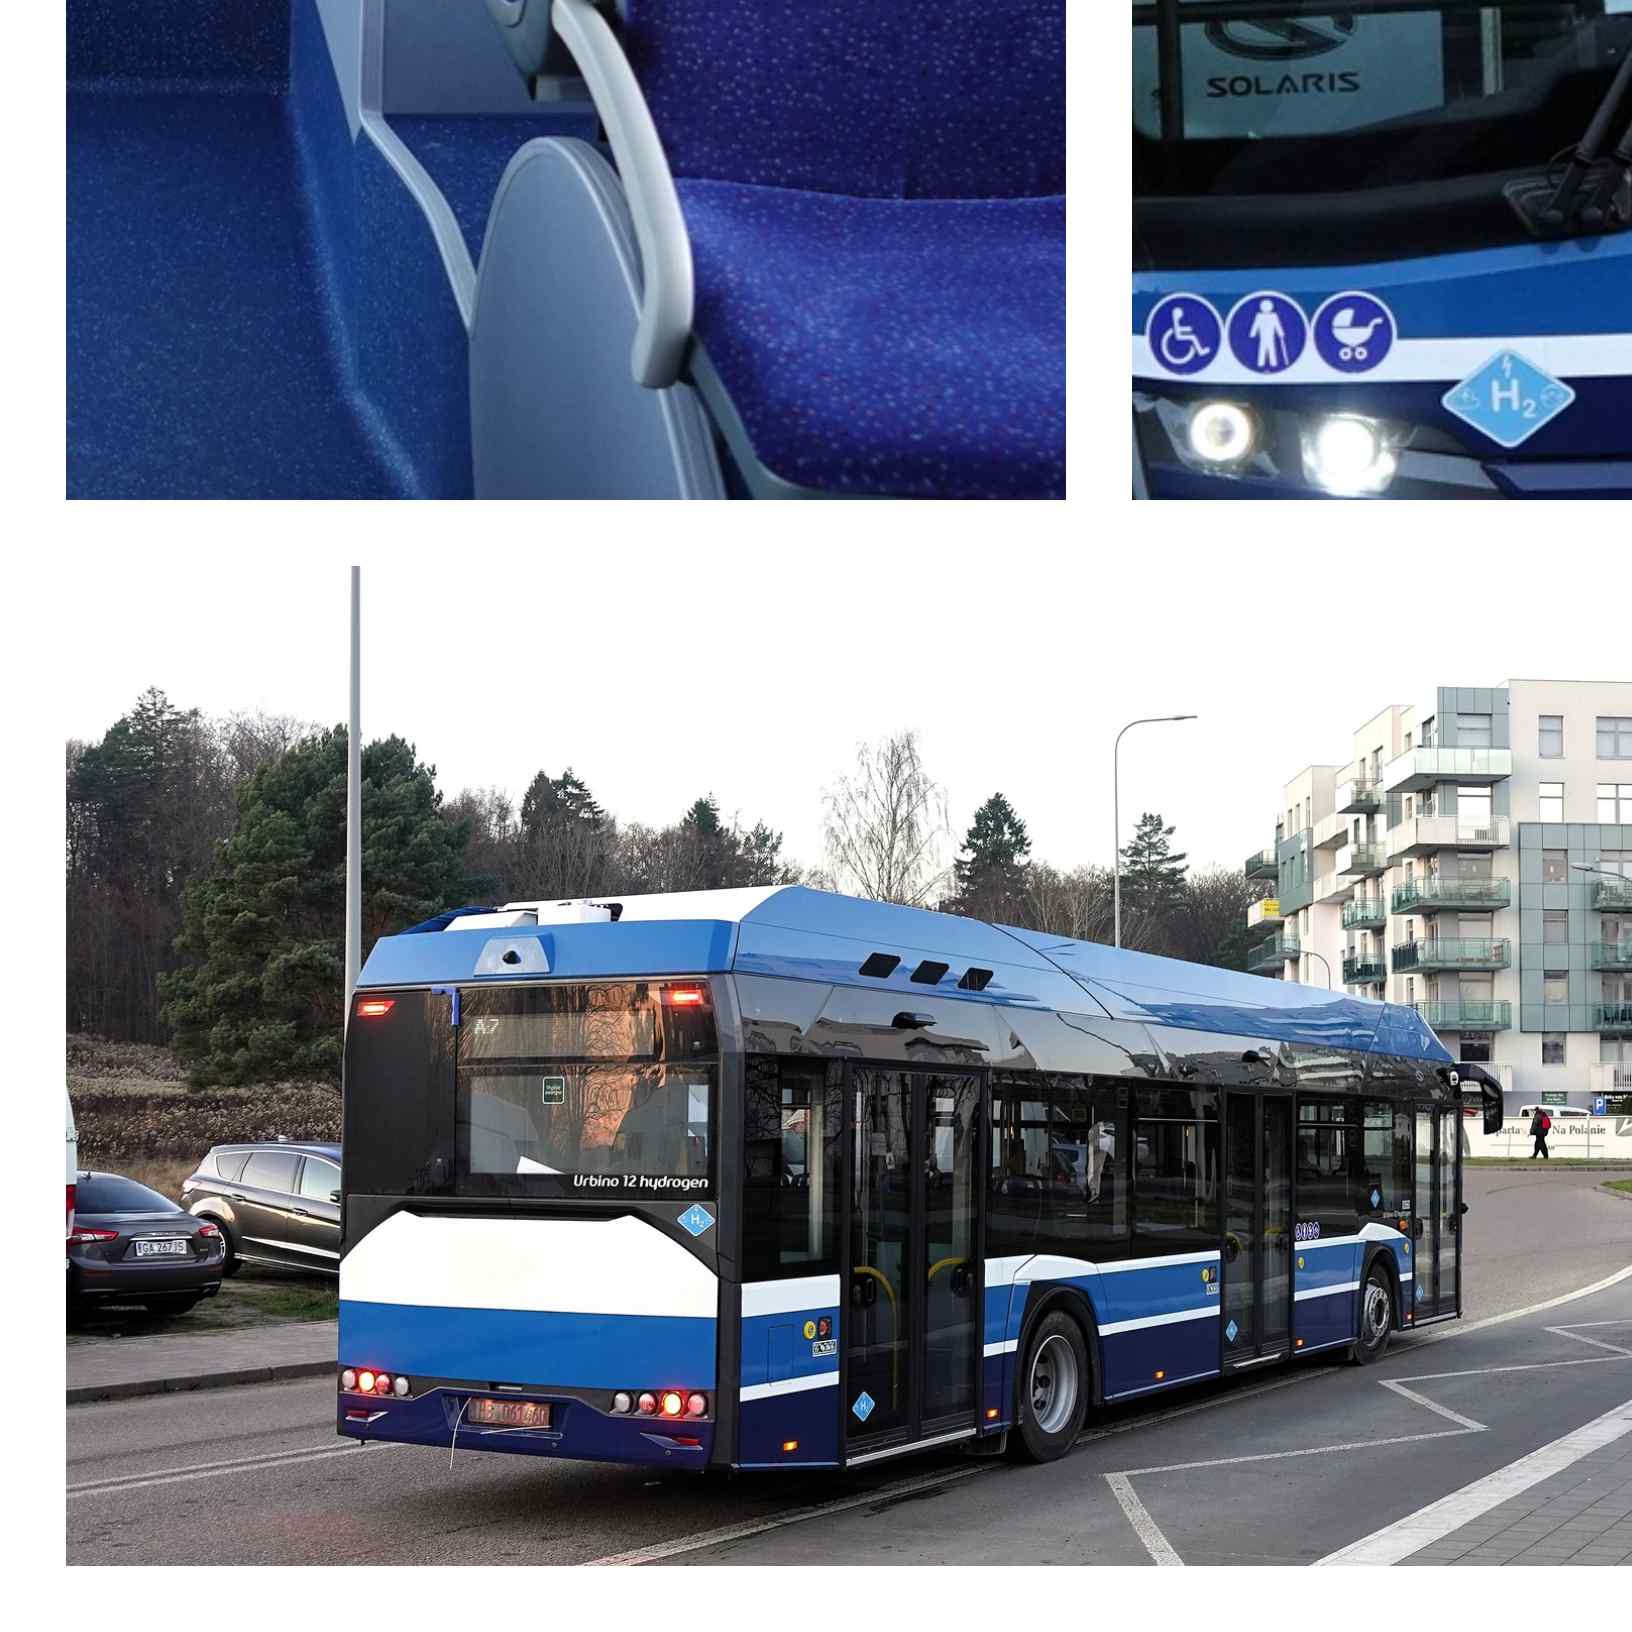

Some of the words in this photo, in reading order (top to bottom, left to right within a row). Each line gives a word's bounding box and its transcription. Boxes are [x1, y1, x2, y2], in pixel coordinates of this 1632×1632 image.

[1207, 72, 1360, 98] SOLARIS
[573, 1174, 619, 1188] Urbino
[624, 1175, 637, 1188] 12
[639, 1175, 709, 1191] hydrogen
